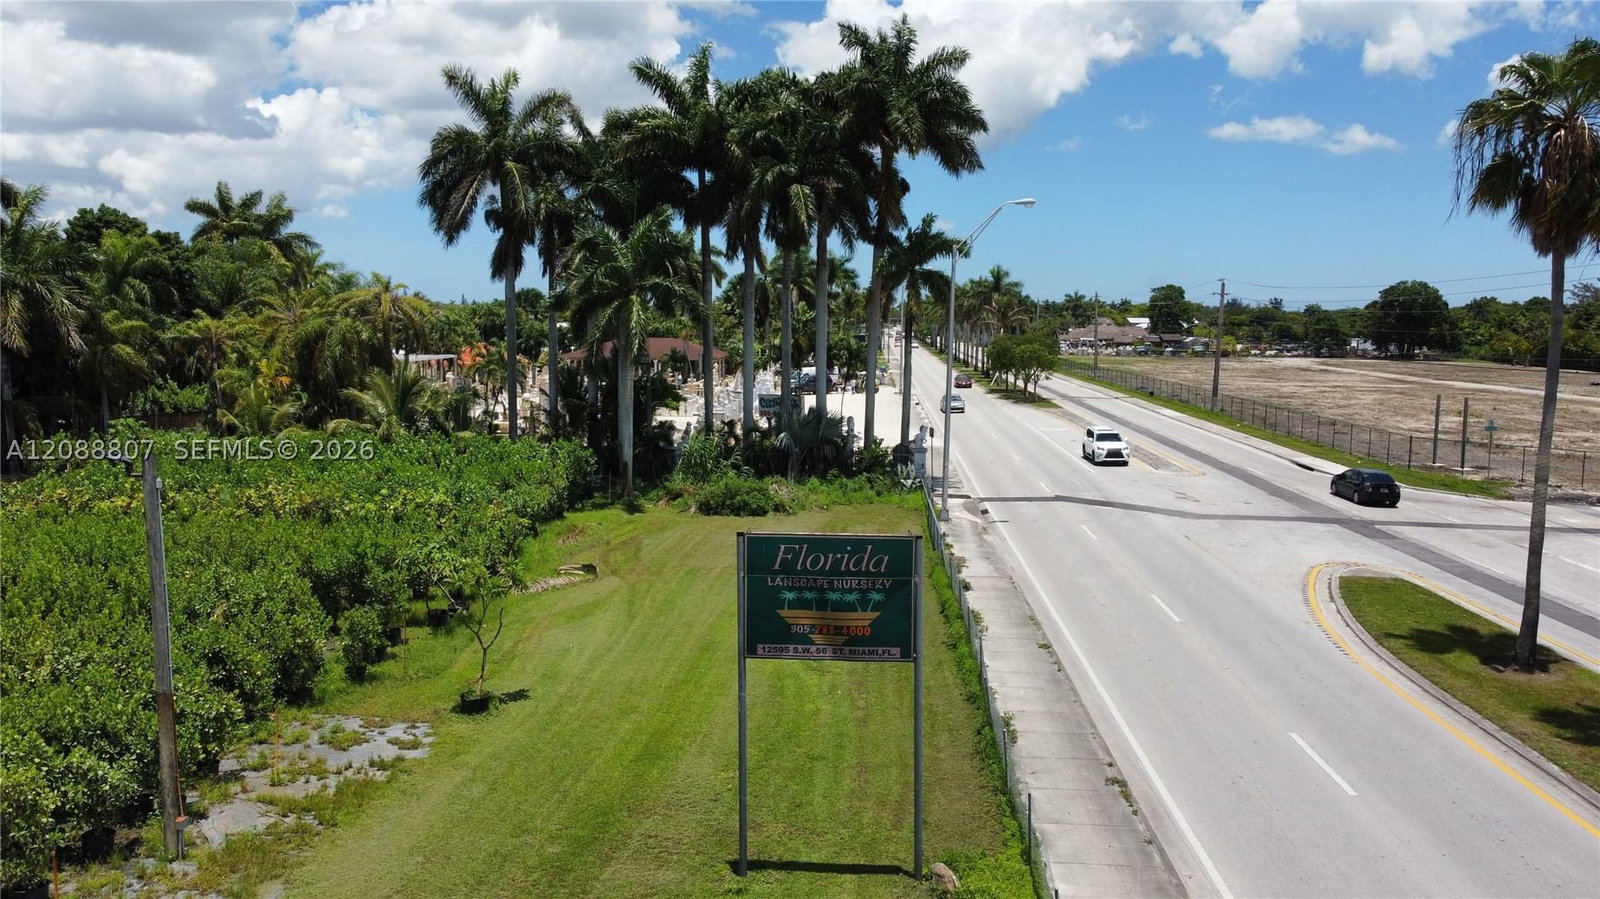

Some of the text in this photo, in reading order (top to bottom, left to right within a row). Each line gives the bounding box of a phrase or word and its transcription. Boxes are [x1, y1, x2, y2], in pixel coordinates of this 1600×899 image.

[771, 543, 890, 573] Florida
[767, 577, 893, 590] LANSCAPE NURSERY
[760, 645, 790, 654] 12595
[792, 646, 813, 655] S.W.
[815, 646, 827, 655] 56
[831, 647, 847, 656] ST.
